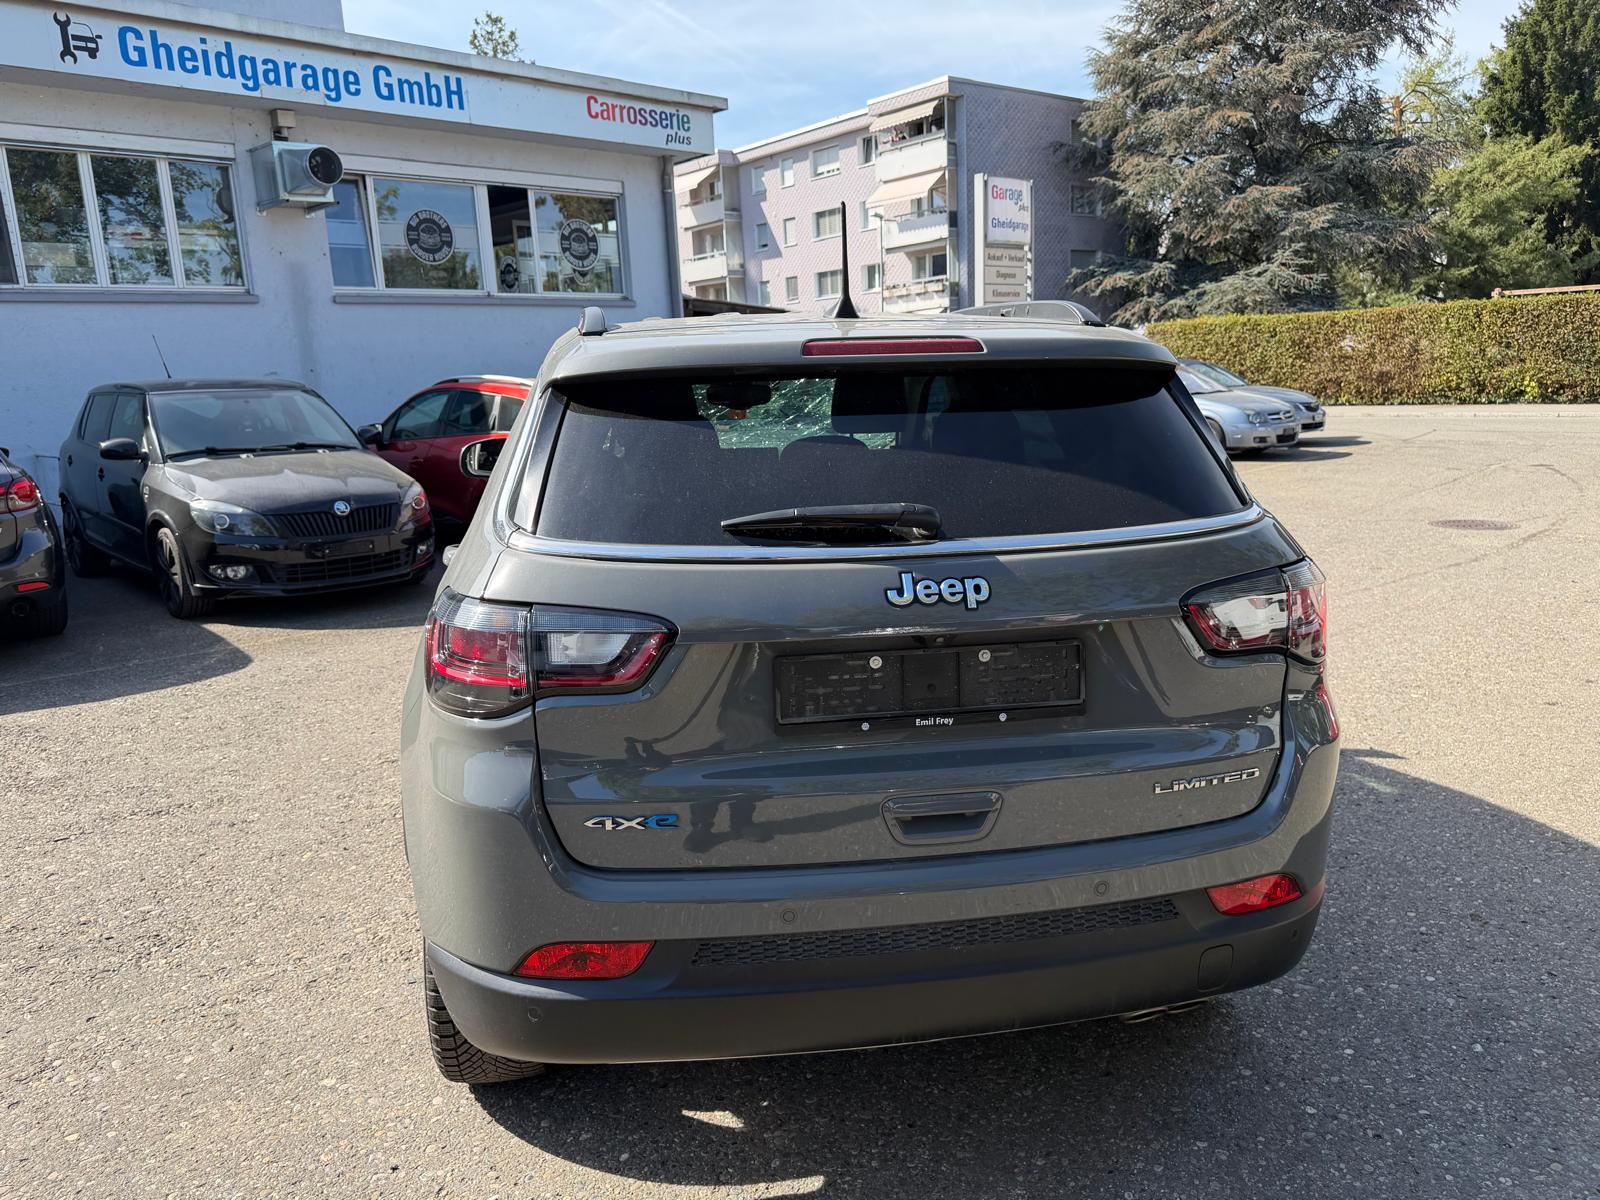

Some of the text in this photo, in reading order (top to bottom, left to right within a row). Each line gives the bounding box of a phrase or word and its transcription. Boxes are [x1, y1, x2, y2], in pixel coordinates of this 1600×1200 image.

[117, 25, 465, 110] Gheidgarage GmbH
[586, 95, 691, 132] Carrosserie
[665, 131, 692, 145] plus
[991, 184, 1023, 205] Garage
[991, 217, 1029, 233] Gheidgarage
[886, 571, 991, 610] Jeep
[915, 716, 954, 726] Emil Frey
[1154, 767, 1260, 794] LIMITED
